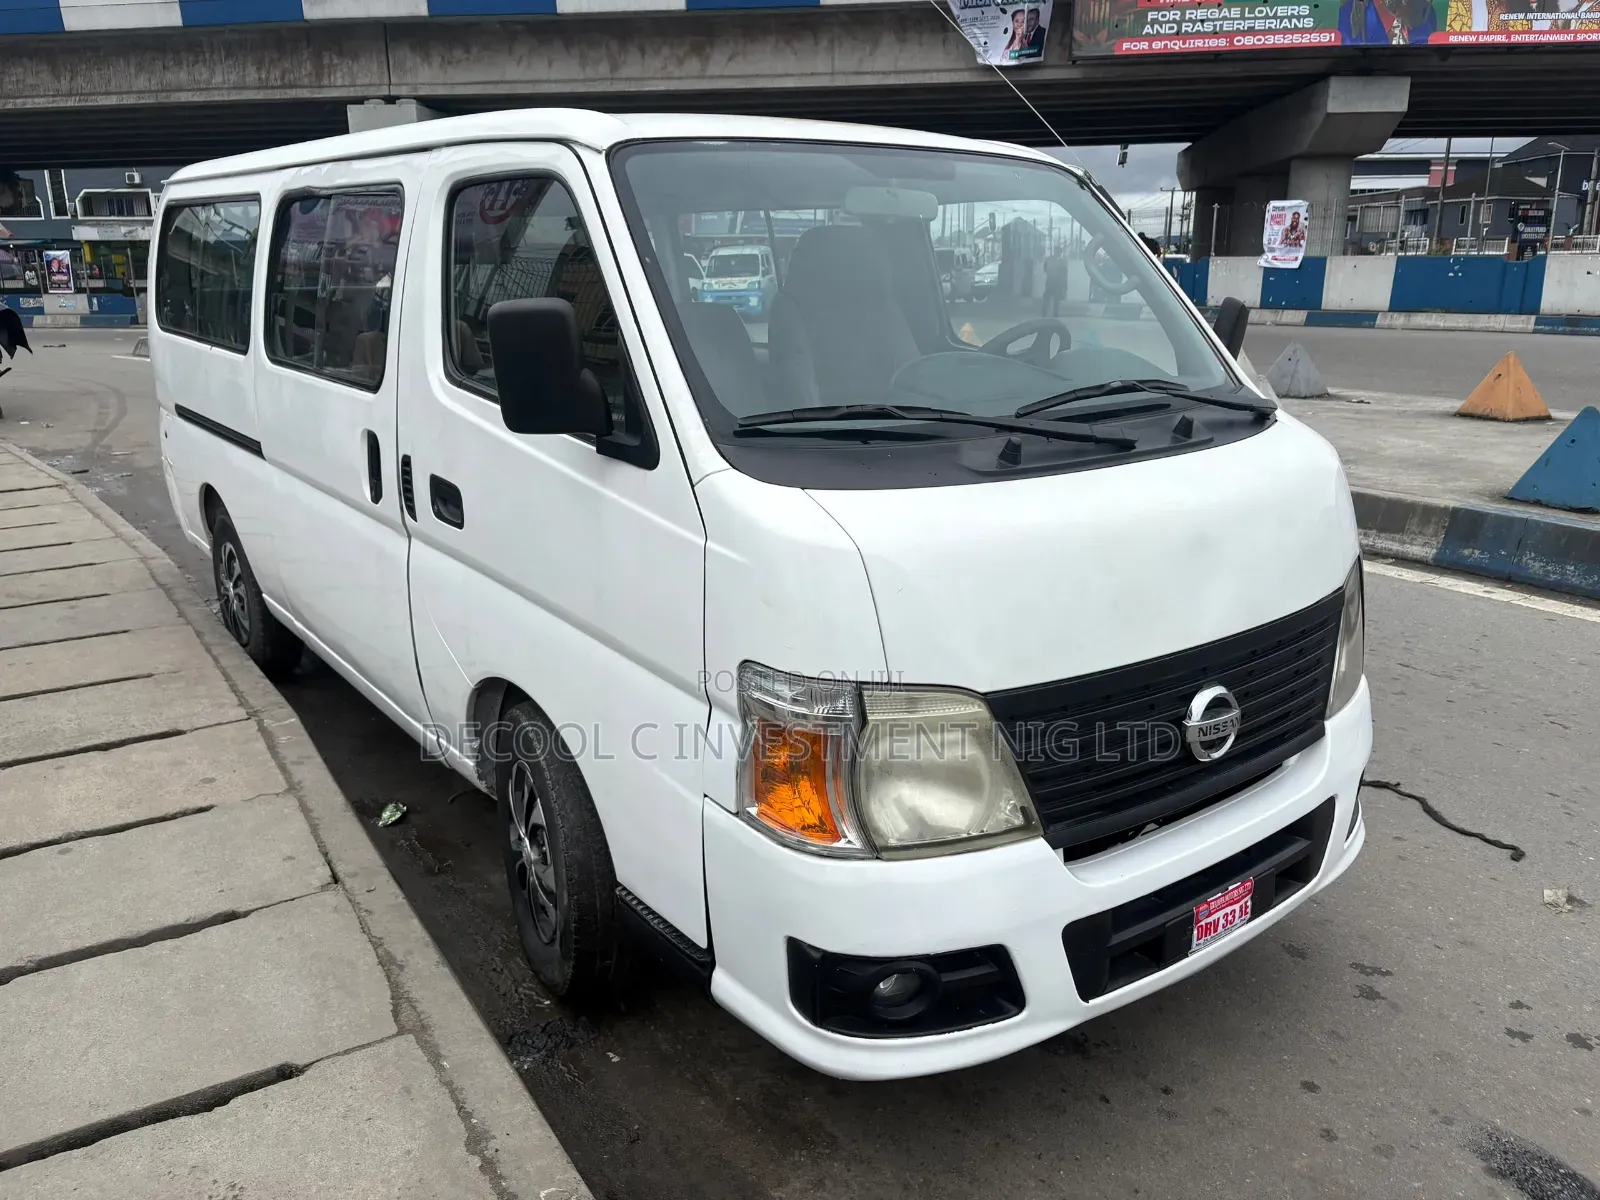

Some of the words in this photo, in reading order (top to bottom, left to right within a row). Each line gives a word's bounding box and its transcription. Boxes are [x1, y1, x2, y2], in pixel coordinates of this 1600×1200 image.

[1147, 10, 1181, 22] FOR
[1185, 8, 1241, 20] REGAE
[1245, 5, 1310, 18] LOVERS
[1527, 12, 1578, 20] INTERNATIONAL
[1142, 24, 1178, 35] AND
[1181, 18, 1314, 33] RASTERFERIANS
[1122, 42, 1149, 51] FOR
[1234, 33, 1336, 45] 08035252591
[1478, 34, 1508, 42] EMPIRE,
[1198, 716, 1240, 738] NISSAN
[1196, 917, 1221, 942] DRV
[1222, 909, 1236, 929] 33
